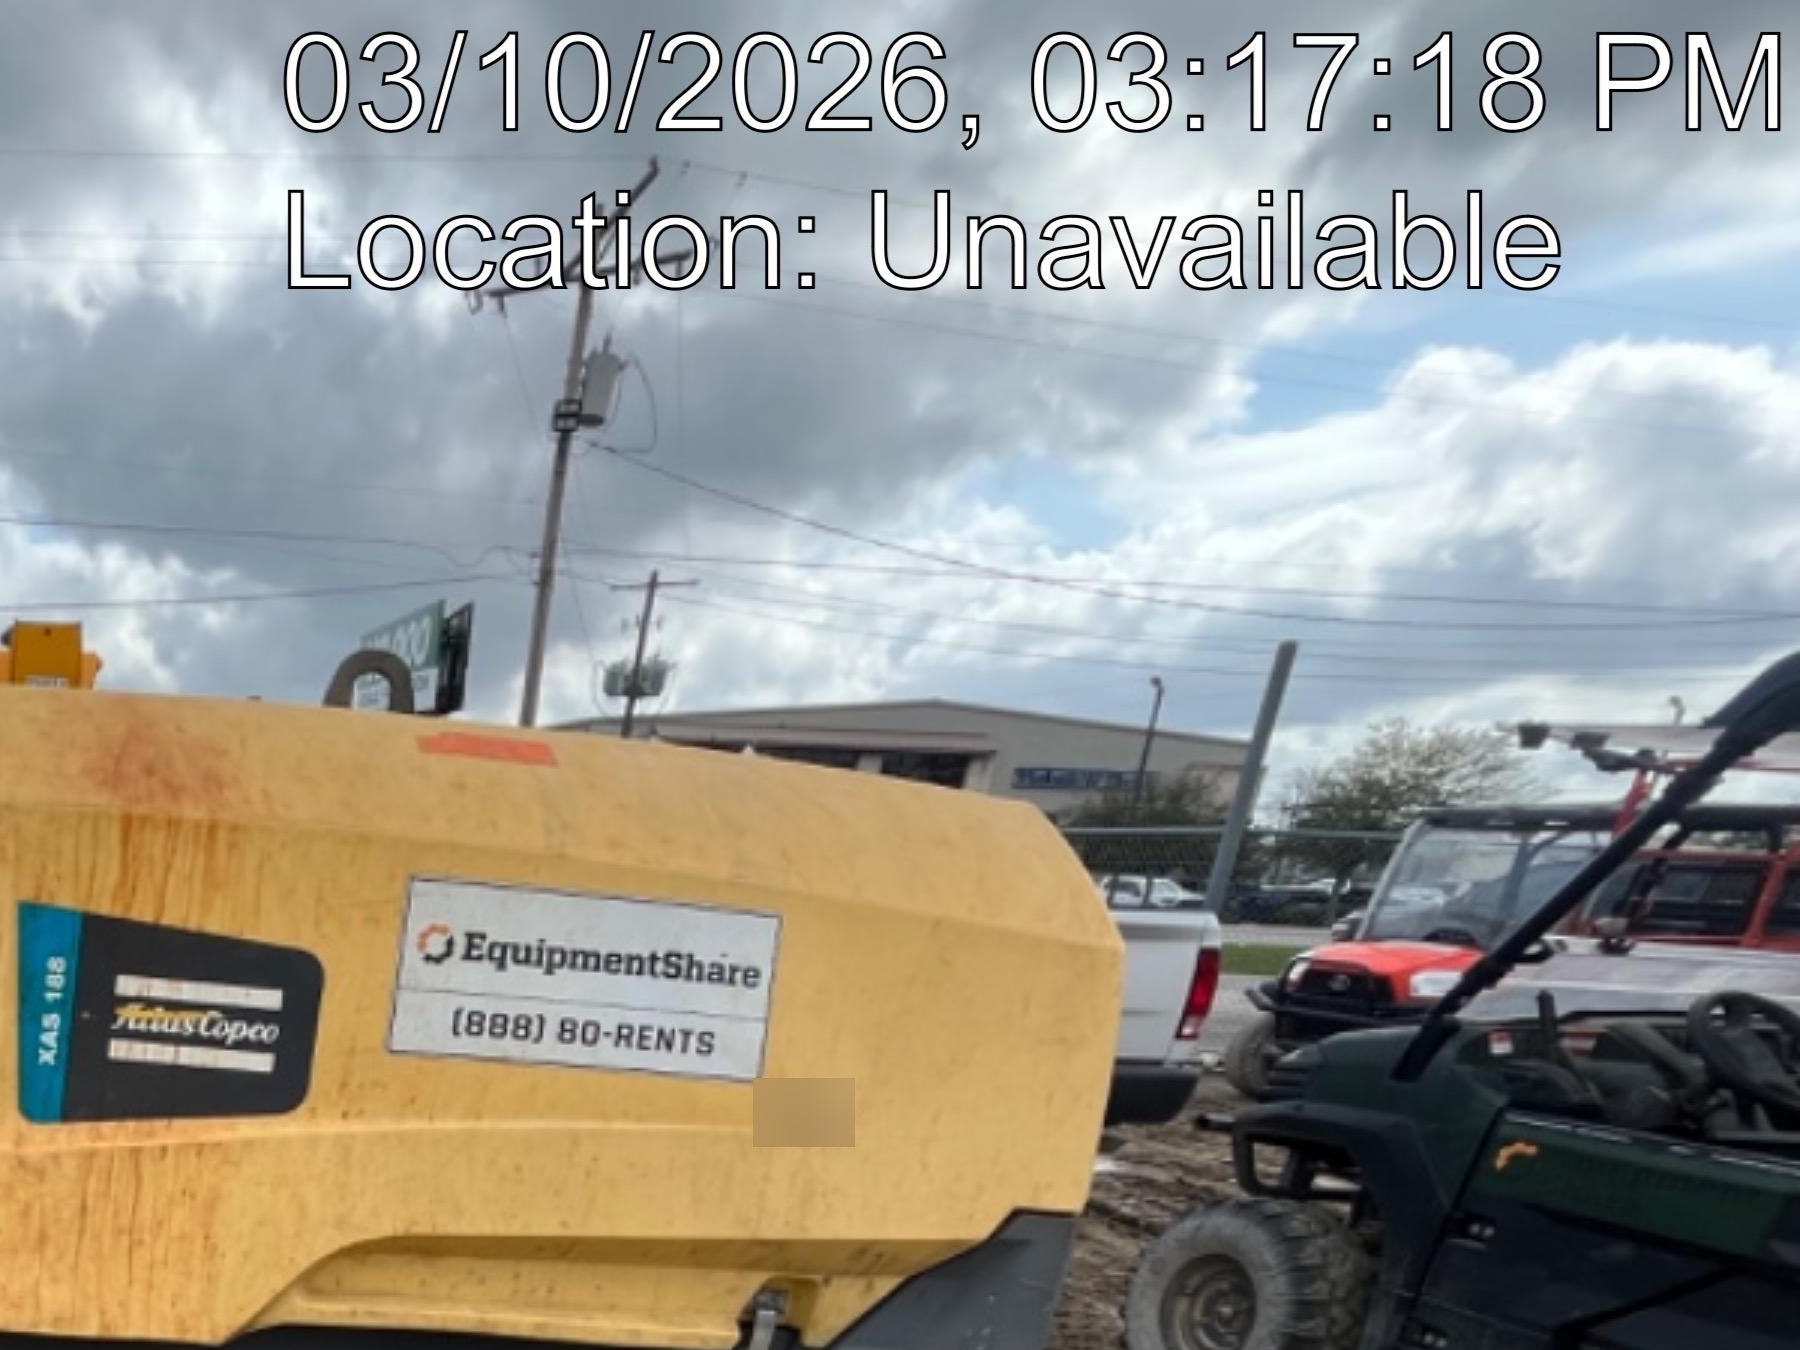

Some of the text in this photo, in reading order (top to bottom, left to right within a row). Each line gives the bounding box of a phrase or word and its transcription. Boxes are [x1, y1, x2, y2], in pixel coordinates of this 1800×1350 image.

[461, 931, 761, 988] EquipmentShare
[38, 1012, 62, 1066] XAS
[197, 1008, 280, 1046] Copco
[452, 1007, 715, 1056] (888) 80-RENTS
